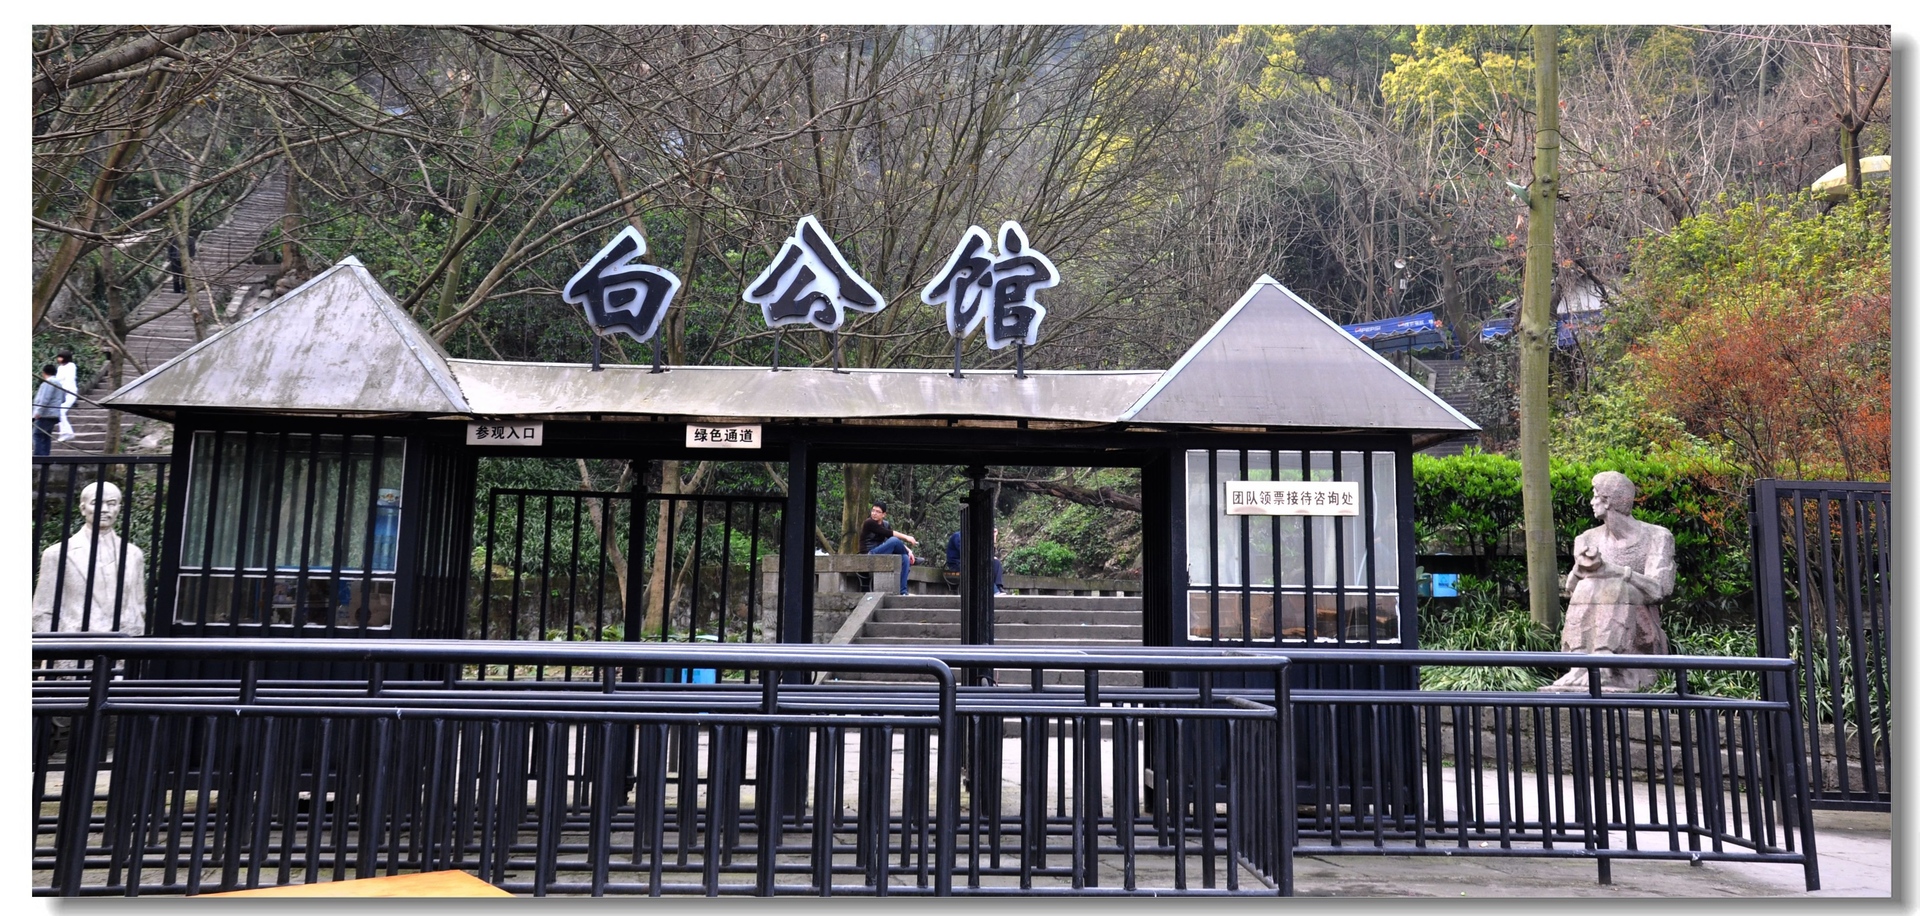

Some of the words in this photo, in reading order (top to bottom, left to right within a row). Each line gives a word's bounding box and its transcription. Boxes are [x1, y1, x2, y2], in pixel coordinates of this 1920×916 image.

[564, 217, 1059, 348] 白公馆
[1360, 325, 1381, 333] PEPSI
[475, 426, 535, 440] 参观入口
[694, 428, 753, 443] 绿色通道
[1232, 490, 1354, 506] 团队领票接待咨询处
